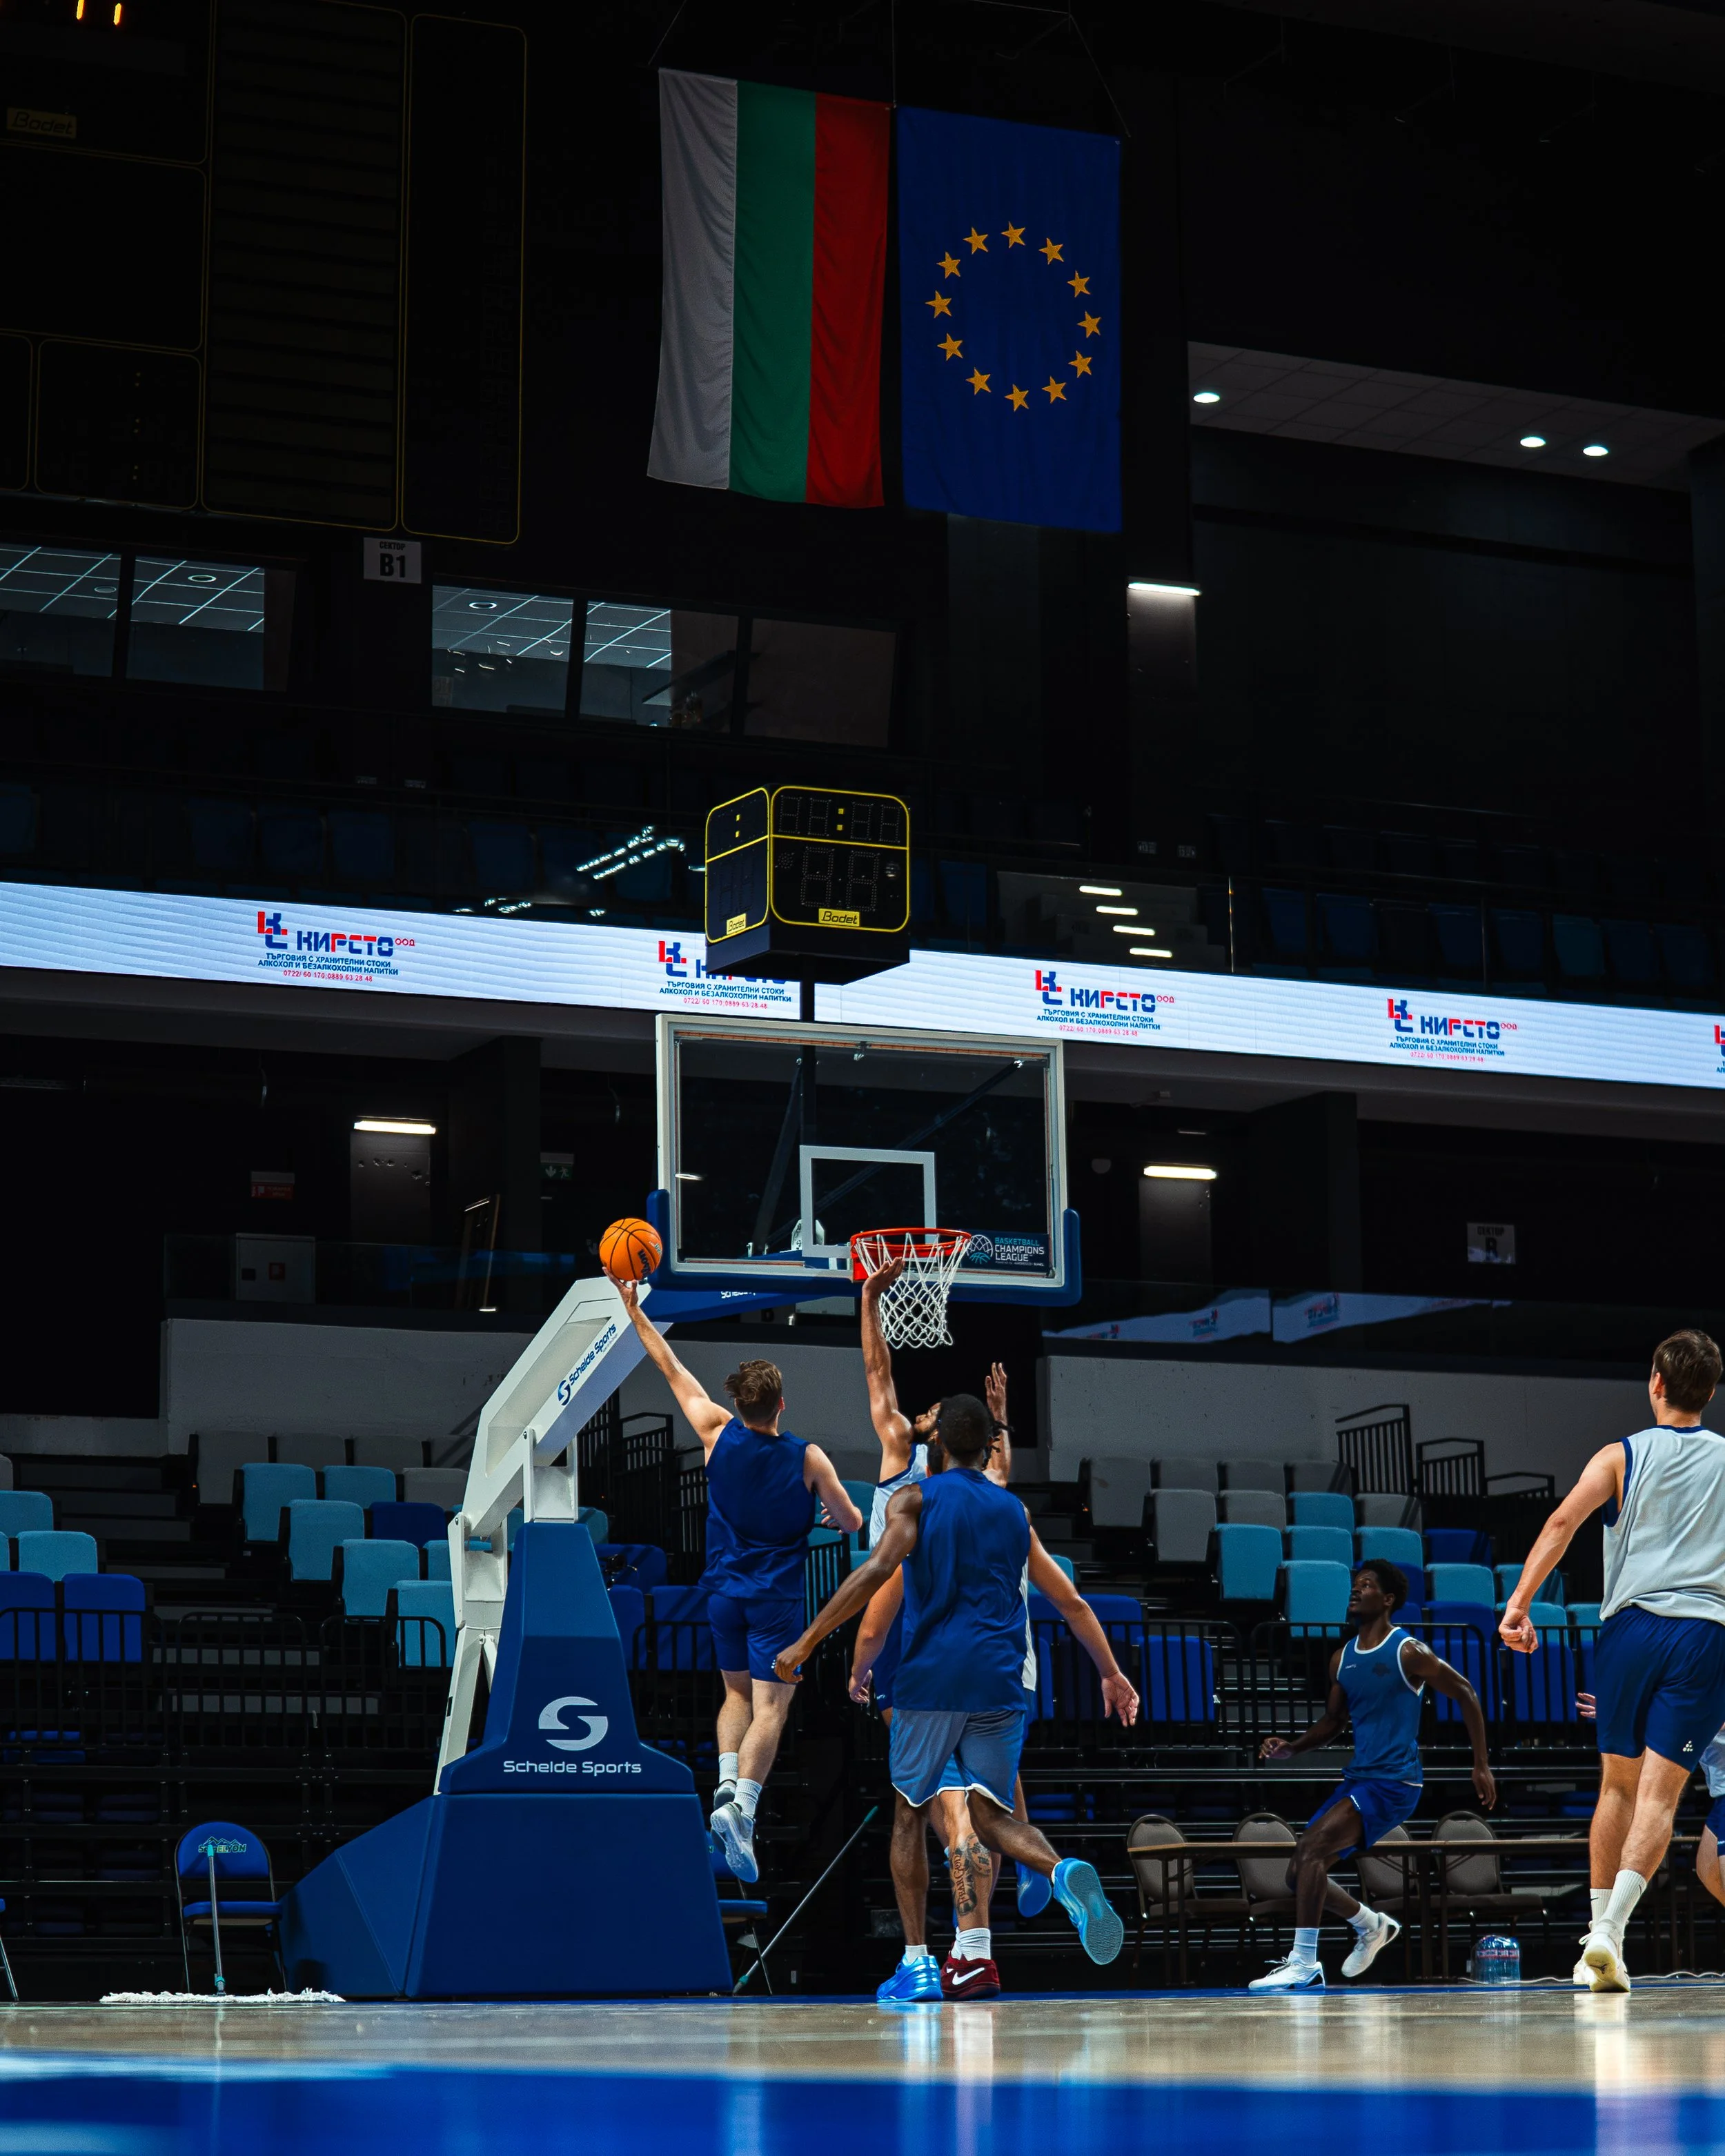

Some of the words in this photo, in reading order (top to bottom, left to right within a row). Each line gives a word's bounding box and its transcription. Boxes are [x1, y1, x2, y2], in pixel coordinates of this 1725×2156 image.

[12, 111, 72, 135] Bodet
[379, 541, 406, 551] СЕКТОР
[729, 918, 745, 933] Bodet
[821, 911, 858, 925] Bodet
[297, 930, 393, 957] КИРСТО
[257, 960, 293, 968] АЛКОХОЛ
[302, 962, 362, 973] БЕЗАЛКОХОЛНИ
[364, 967, 399, 976] НАПИТКИ
[266, 953, 306, 962] ТЪРГОВИЯ
[315, 956, 364, 966] ХРАНИТЕЛНИ
[366, 960, 391, 968] СТОКИ
[659, 987, 693, 996] АЛКОХОЛ
[701, 990, 758, 1000] БЕЗАЛКОХОЛНИ
[759, 994, 792, 1002] НАПИТКИ
[667, 981, 705, 989] ТЪРГОВИЯ
[713, 984, 760, 993] ХРАНИТЕЛНИ
[1070, 988, 1156, 1013] КИРСТО
[1043, 1009, 1079, 1017] ТЪРГОВИЯ
[1087, 1012, 1131, 1021] ХРАНИТЕЛНИ
[1076, 1018, 1129, 1028] БЕЗАЛКОХОЛНИ
[1420, 1016, 1500, 1040] КИРСТО
[994, 1237, 1040, 1246] BASKETBALL
[994, 1245, 1045, 1254] CHAMPIONS
[569, 1351, 595, 1386] Schelde
[594, 1323, 617, 1354] Sports
[503, 1761, 577, 1772] Schelde
[582, 1761, 642, 1777] Sports
